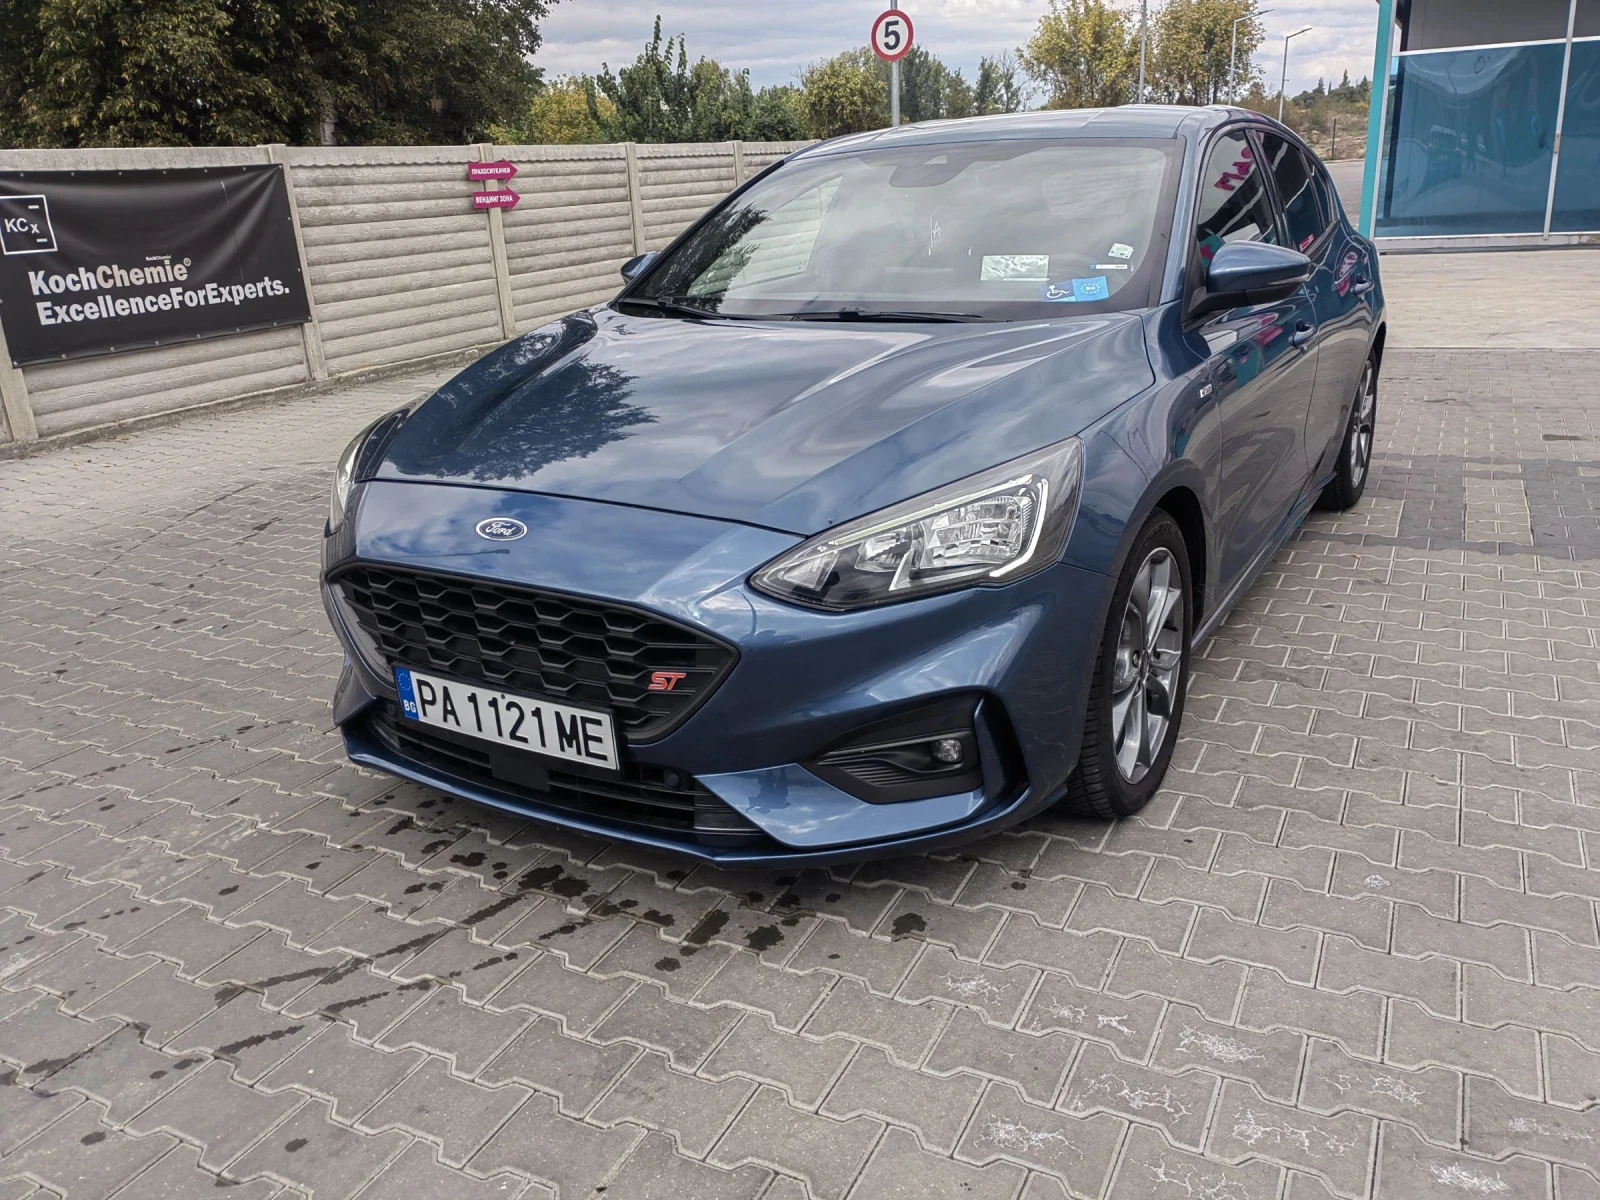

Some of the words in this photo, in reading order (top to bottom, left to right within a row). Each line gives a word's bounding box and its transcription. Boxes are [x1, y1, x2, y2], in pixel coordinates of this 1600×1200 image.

[884, 20, 900, 50] 5
[36, 276, 290, 326] ExcellenceForExperts.
[485, 521, 517, 536] Ford
[648, 672, 687, 690] ST
[403, 699, 417, 713] BG
